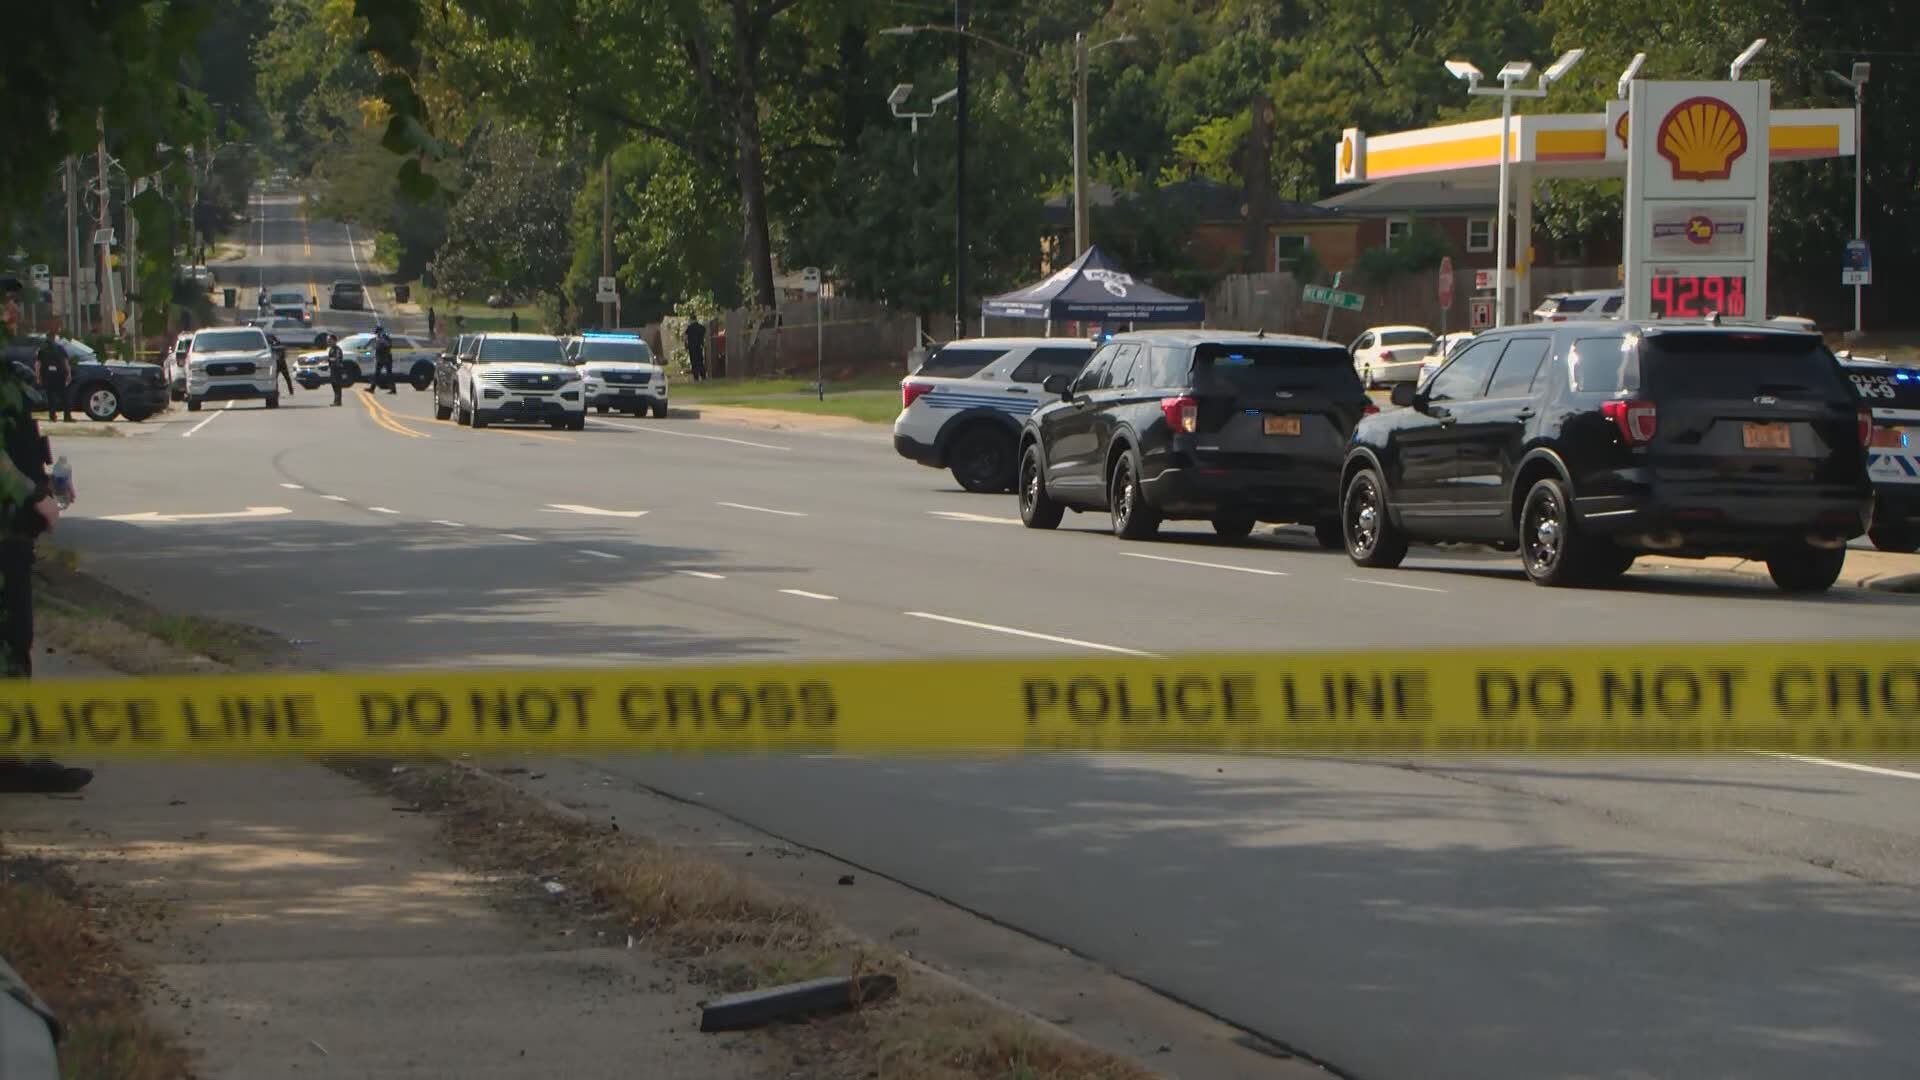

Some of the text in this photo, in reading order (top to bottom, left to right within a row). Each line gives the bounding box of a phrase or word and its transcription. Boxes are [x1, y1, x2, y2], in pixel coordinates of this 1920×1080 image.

[1855, 383, 1896, 399] K-9
[181, 692, 322, 741] LINE
[358, 688, 450, 738] DO
[470, 686, 594, 733] NOT
[617, 680, 838, 733] CROSS
[1022, 663, 1920, 726] POLICE LINE DO NOT CRO
